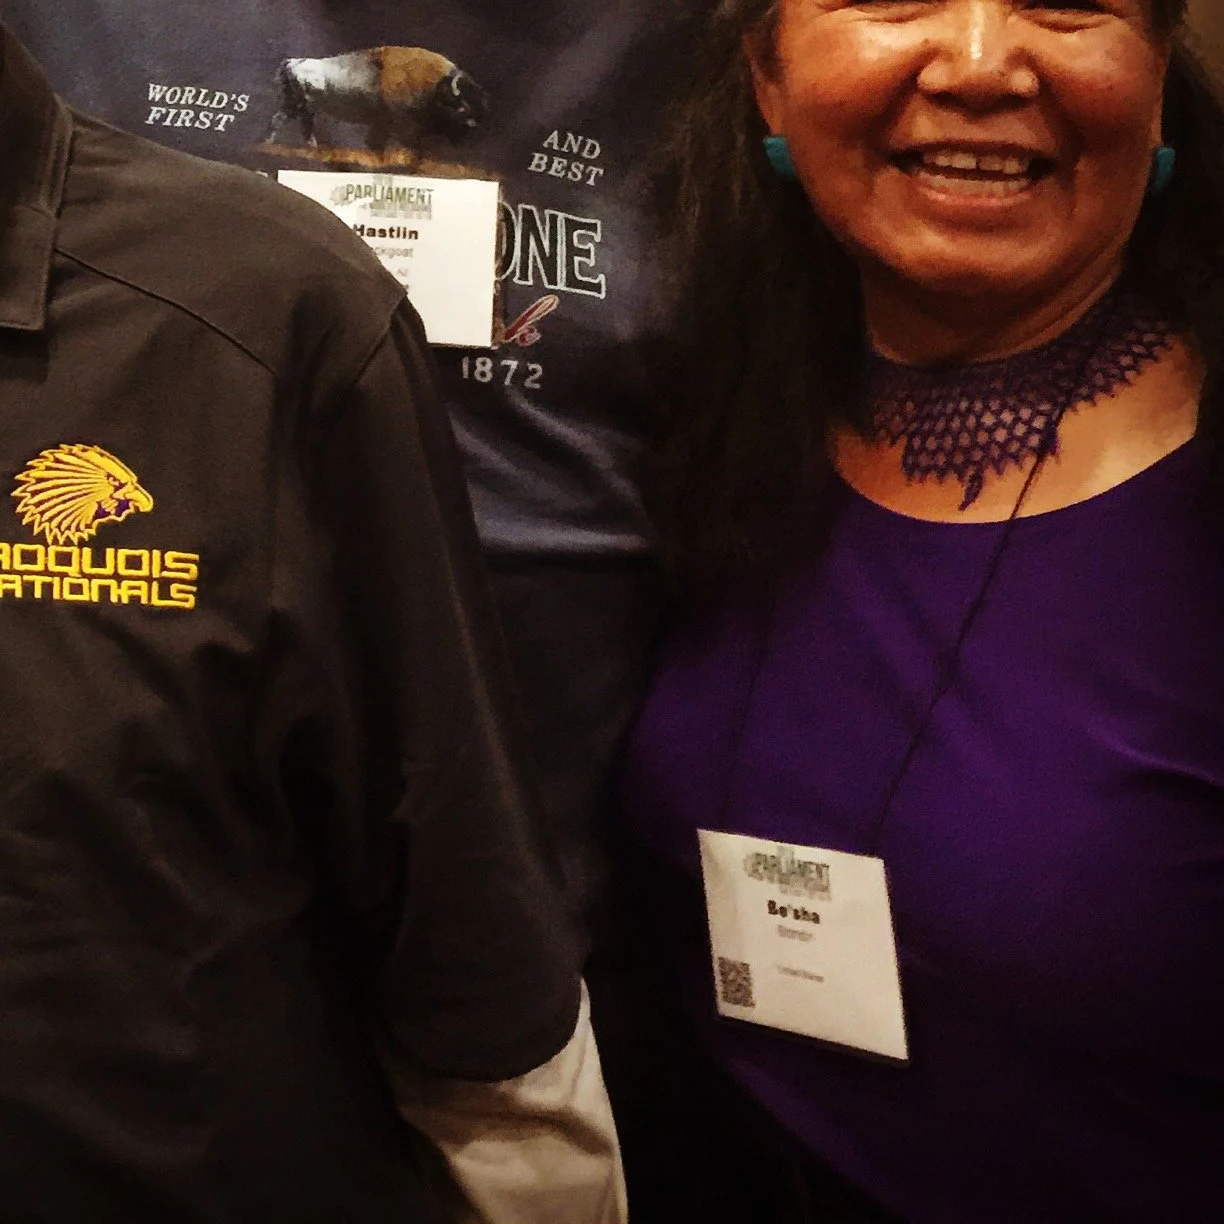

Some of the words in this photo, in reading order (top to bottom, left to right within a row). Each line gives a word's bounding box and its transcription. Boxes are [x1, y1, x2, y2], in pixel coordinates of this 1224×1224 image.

[147, 83, 250, 114] WORLD'S
[144, 106, 235, 133] FIRST
[542, 129, 602, 160] AND
[527, 152, 605, 187] BEST
[345, 183, 434, 205] PARLIAMENT
[461, 355, 544, 390] 1872
